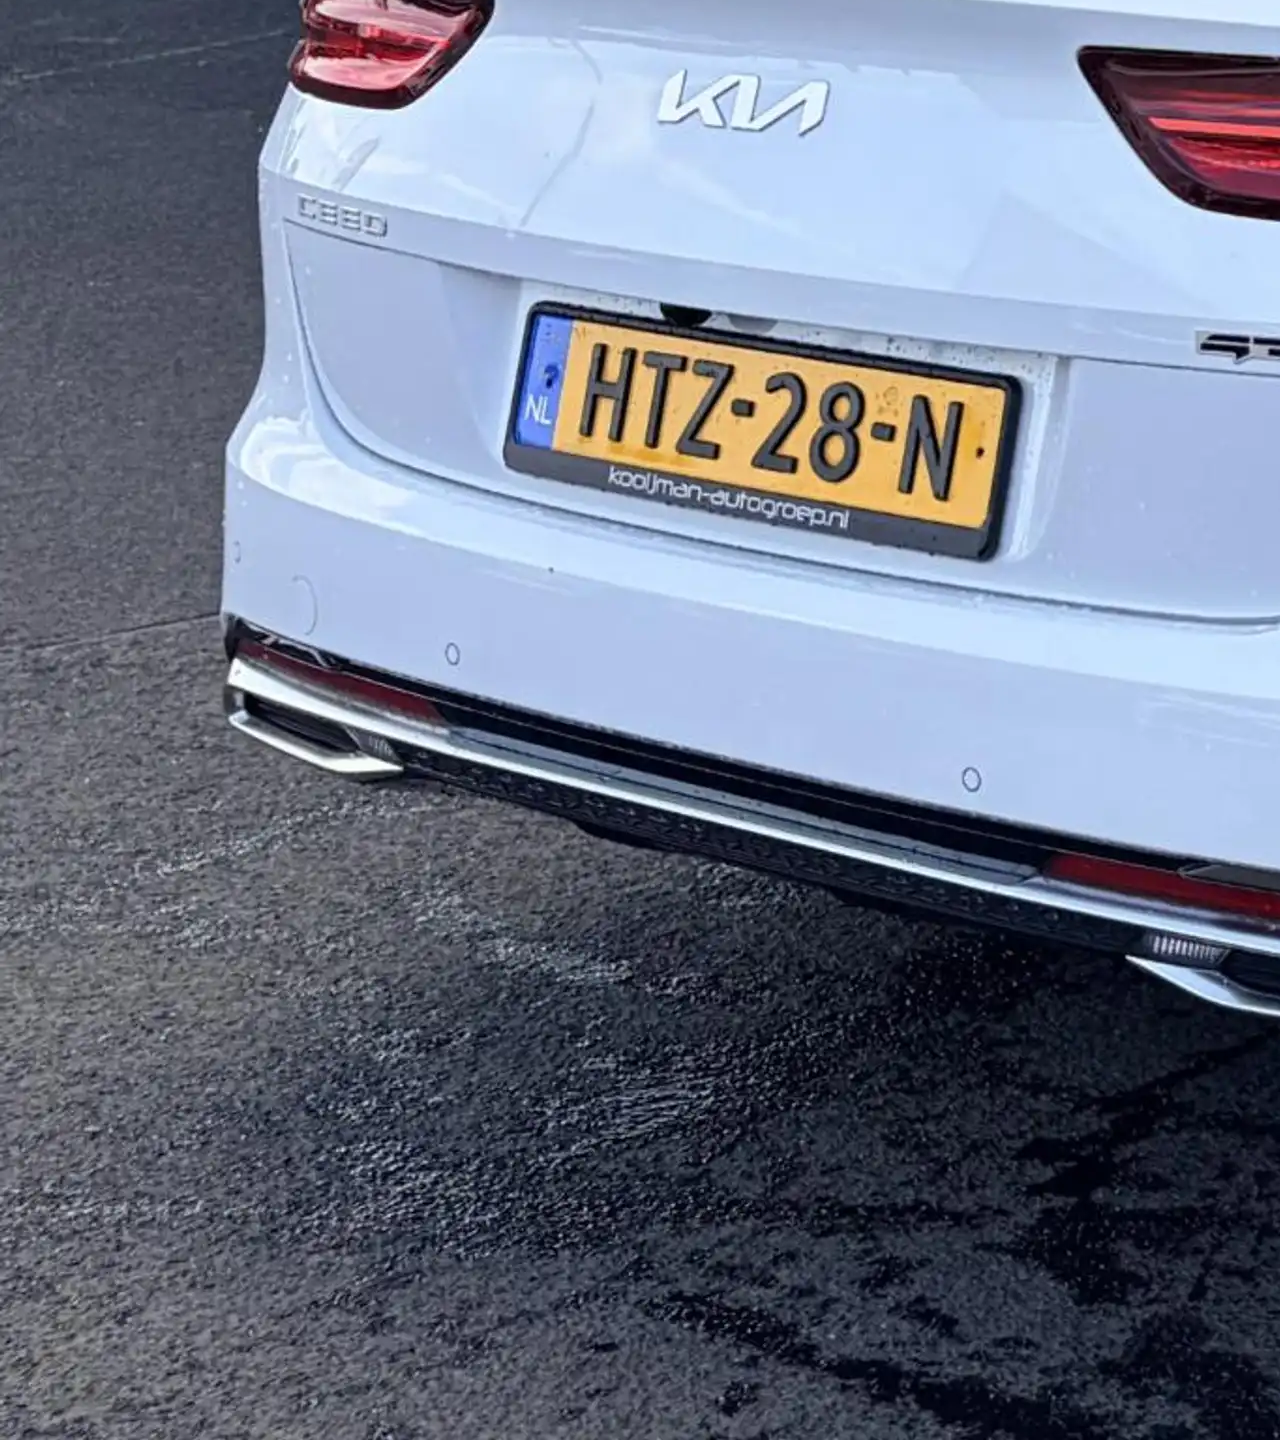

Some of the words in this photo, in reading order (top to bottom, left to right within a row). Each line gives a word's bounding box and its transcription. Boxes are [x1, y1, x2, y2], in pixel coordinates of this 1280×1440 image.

[657, 69, 831, 138] KIA
[297, 193, 388, 237] CEED
[524, 393, 552, 426] NL
[579, 342, 965, 503] HTZ-28-N
[607, 465, 850, 530] kooijman-autogroep.nl
